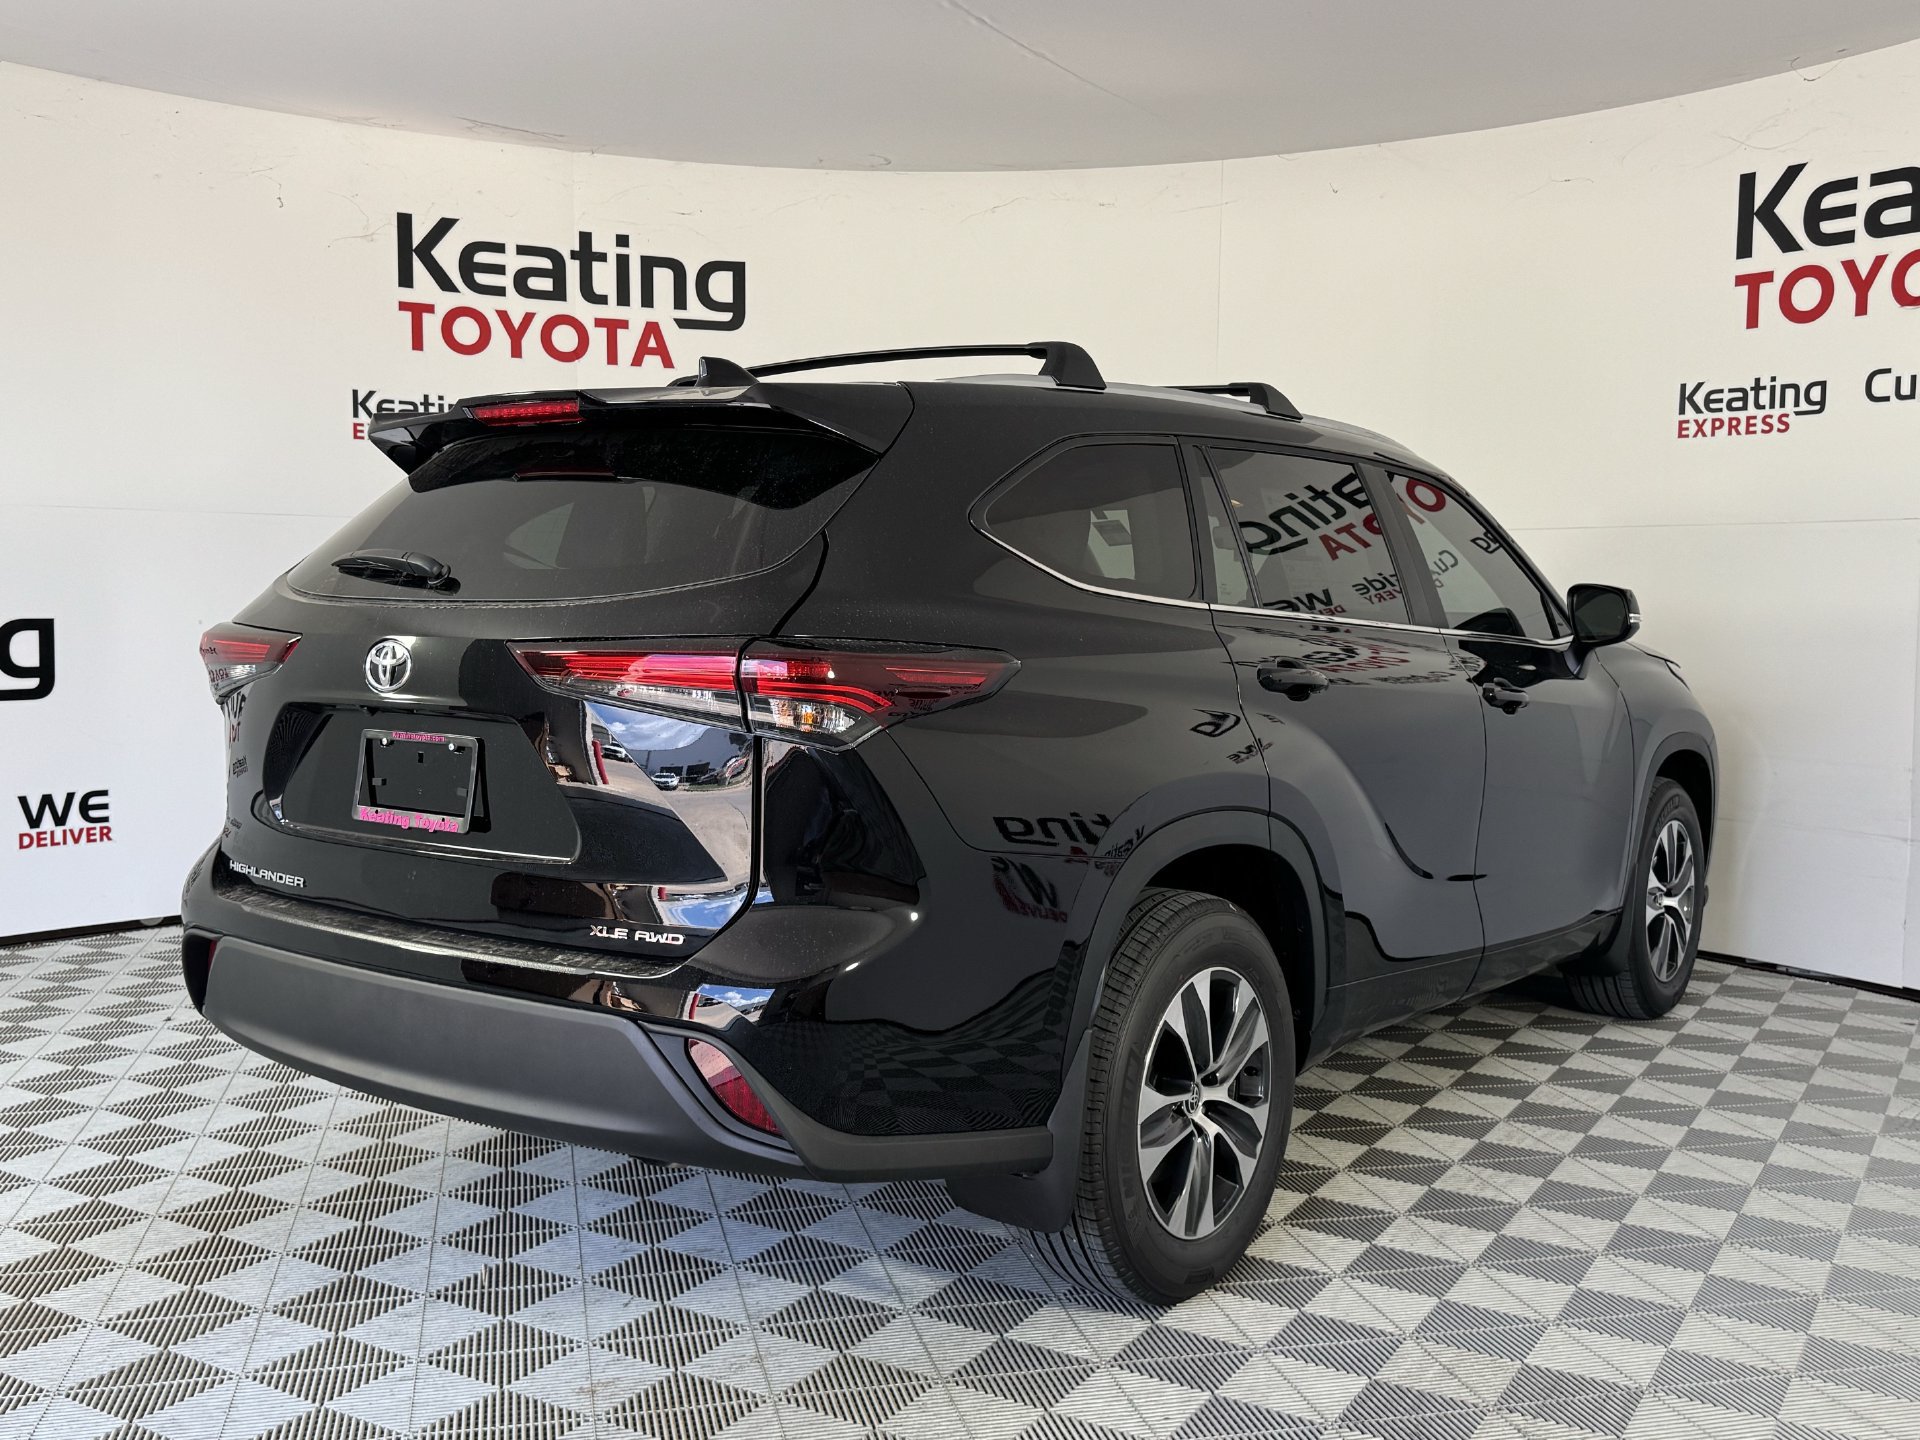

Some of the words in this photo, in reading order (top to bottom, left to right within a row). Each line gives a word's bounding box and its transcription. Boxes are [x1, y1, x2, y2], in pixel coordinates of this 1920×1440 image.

[396, 212, 746, 332] Keating
[398, 301, 676, 370] TOYOTA
[1678, 376, 1828, 417] Keating
[1677, 413, 1791, 439] EXPRESS
[17, 789, 110, 829] WE
[359, 806, 411, 830] Keating
[413, 812, 460, 833] Toyota
[18, 825, 113, 850] DELIVER
[229, 859, 305, 888] HIGHLANDER
[589, 924, 629, 940] XLE
[634, 930, 686, 945] AWD
